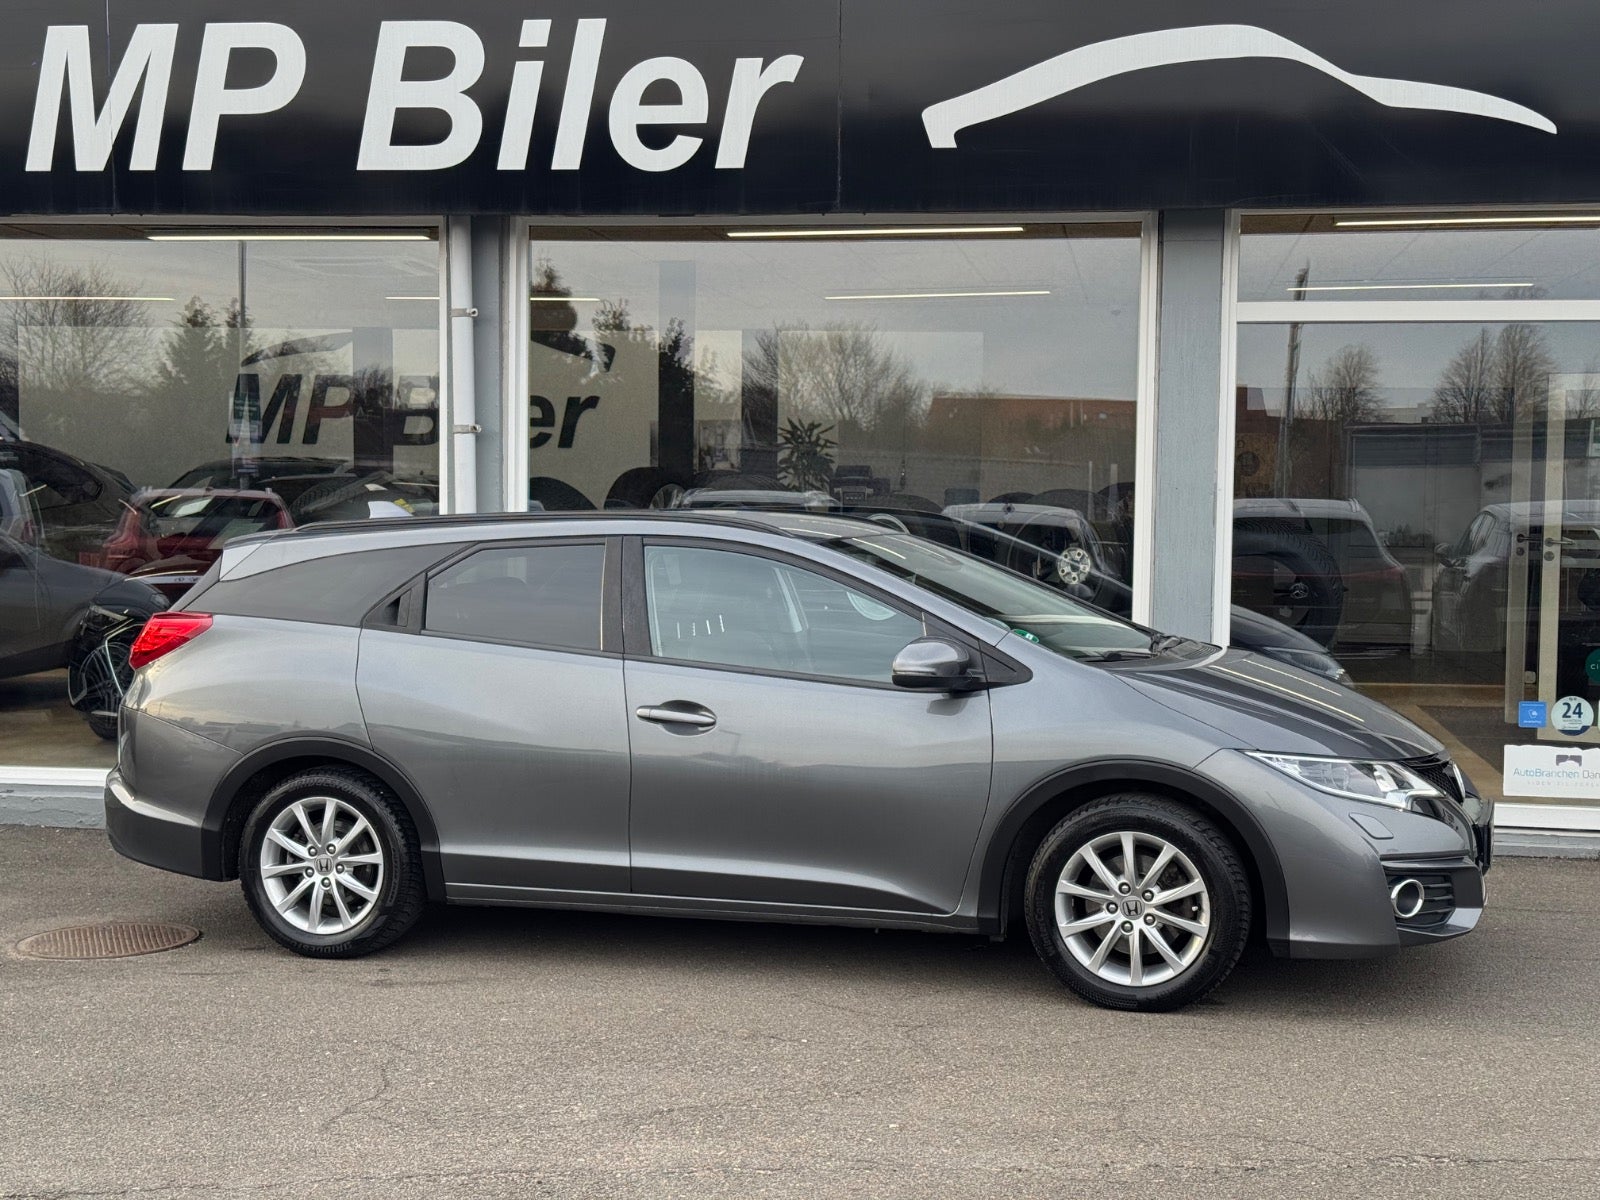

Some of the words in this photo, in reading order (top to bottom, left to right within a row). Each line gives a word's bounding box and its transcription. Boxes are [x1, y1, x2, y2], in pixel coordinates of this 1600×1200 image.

[25, 22, 307, 172] MP
[356, 18, 804, 172] Biler
[226, 373, 356, 445] MP
[1562, 702, 1584, 719] 24
[1513, 767, 1580, 779] AutoBranchen
